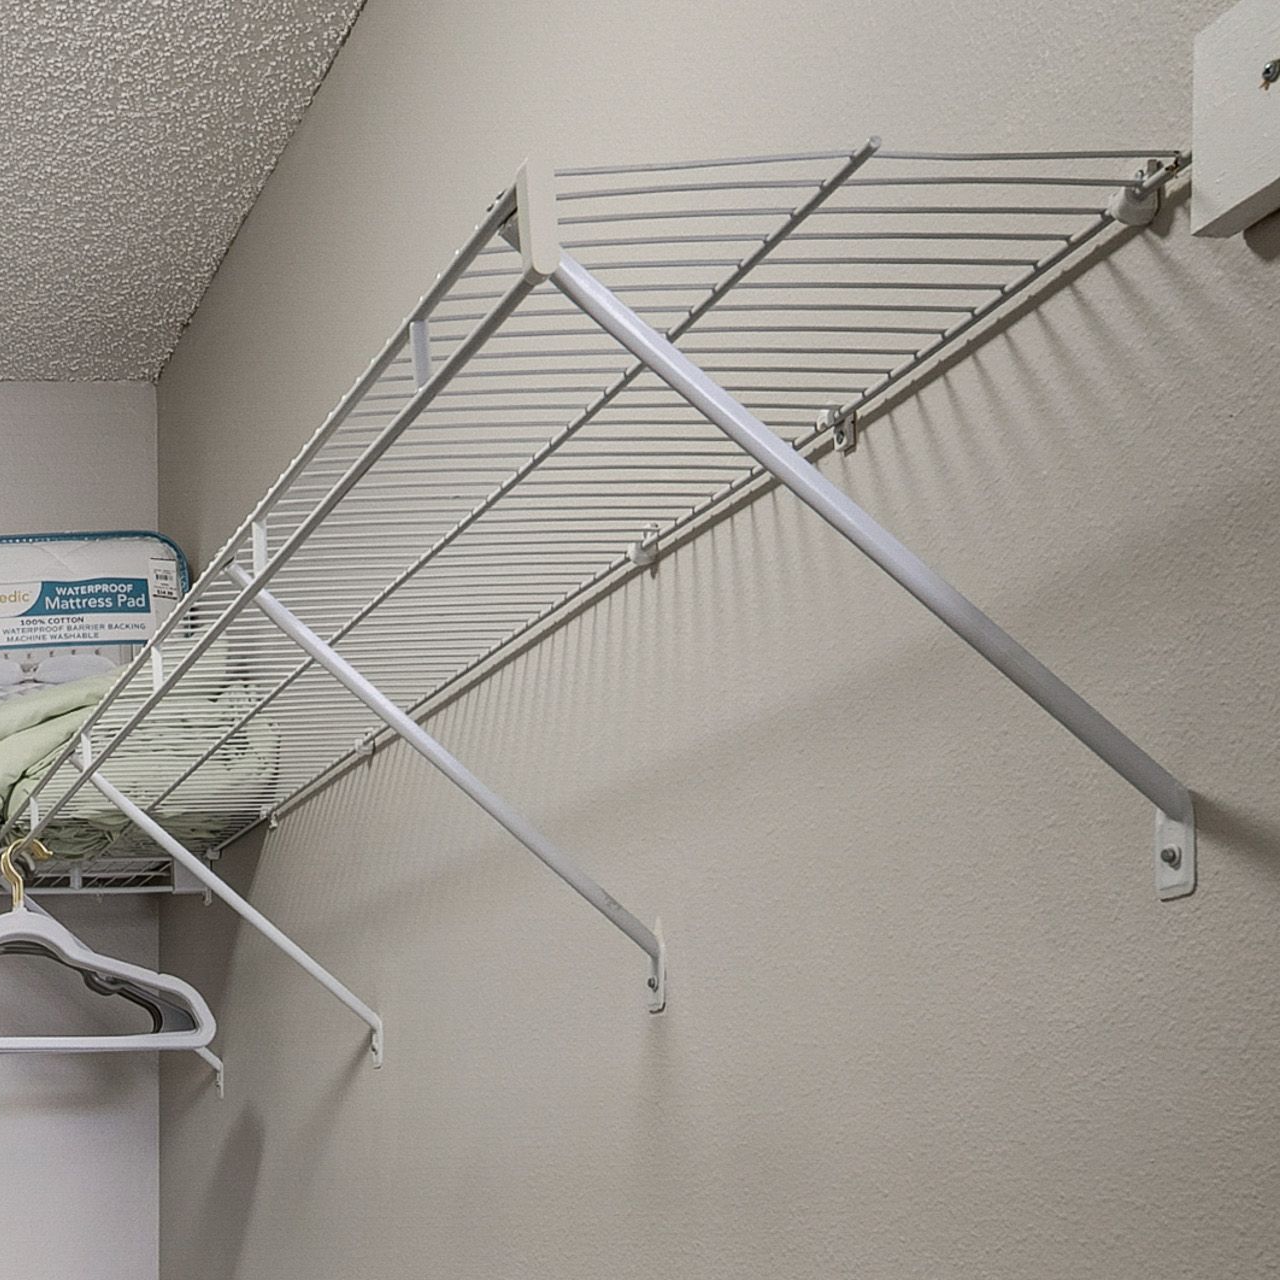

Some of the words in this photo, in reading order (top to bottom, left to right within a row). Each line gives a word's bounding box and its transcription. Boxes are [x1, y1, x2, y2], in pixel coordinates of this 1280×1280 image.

[55, 583, 133, 596] WATERPROOF
[44, 595, 113, 610] Mattress
[116, 593, 146, 608] Pad
[20, 618, 45, 626] 100%
[47, 616, 85, 625] COTTON
[2, 624, 64, 634] WATERPROOF
[66, 623, 105, 632] BARRIER
[107, 622, 146, 630] BACKING
[6, 634, 47, 642] MACHINE
[50, 632, 99, 640] WASHABLE
